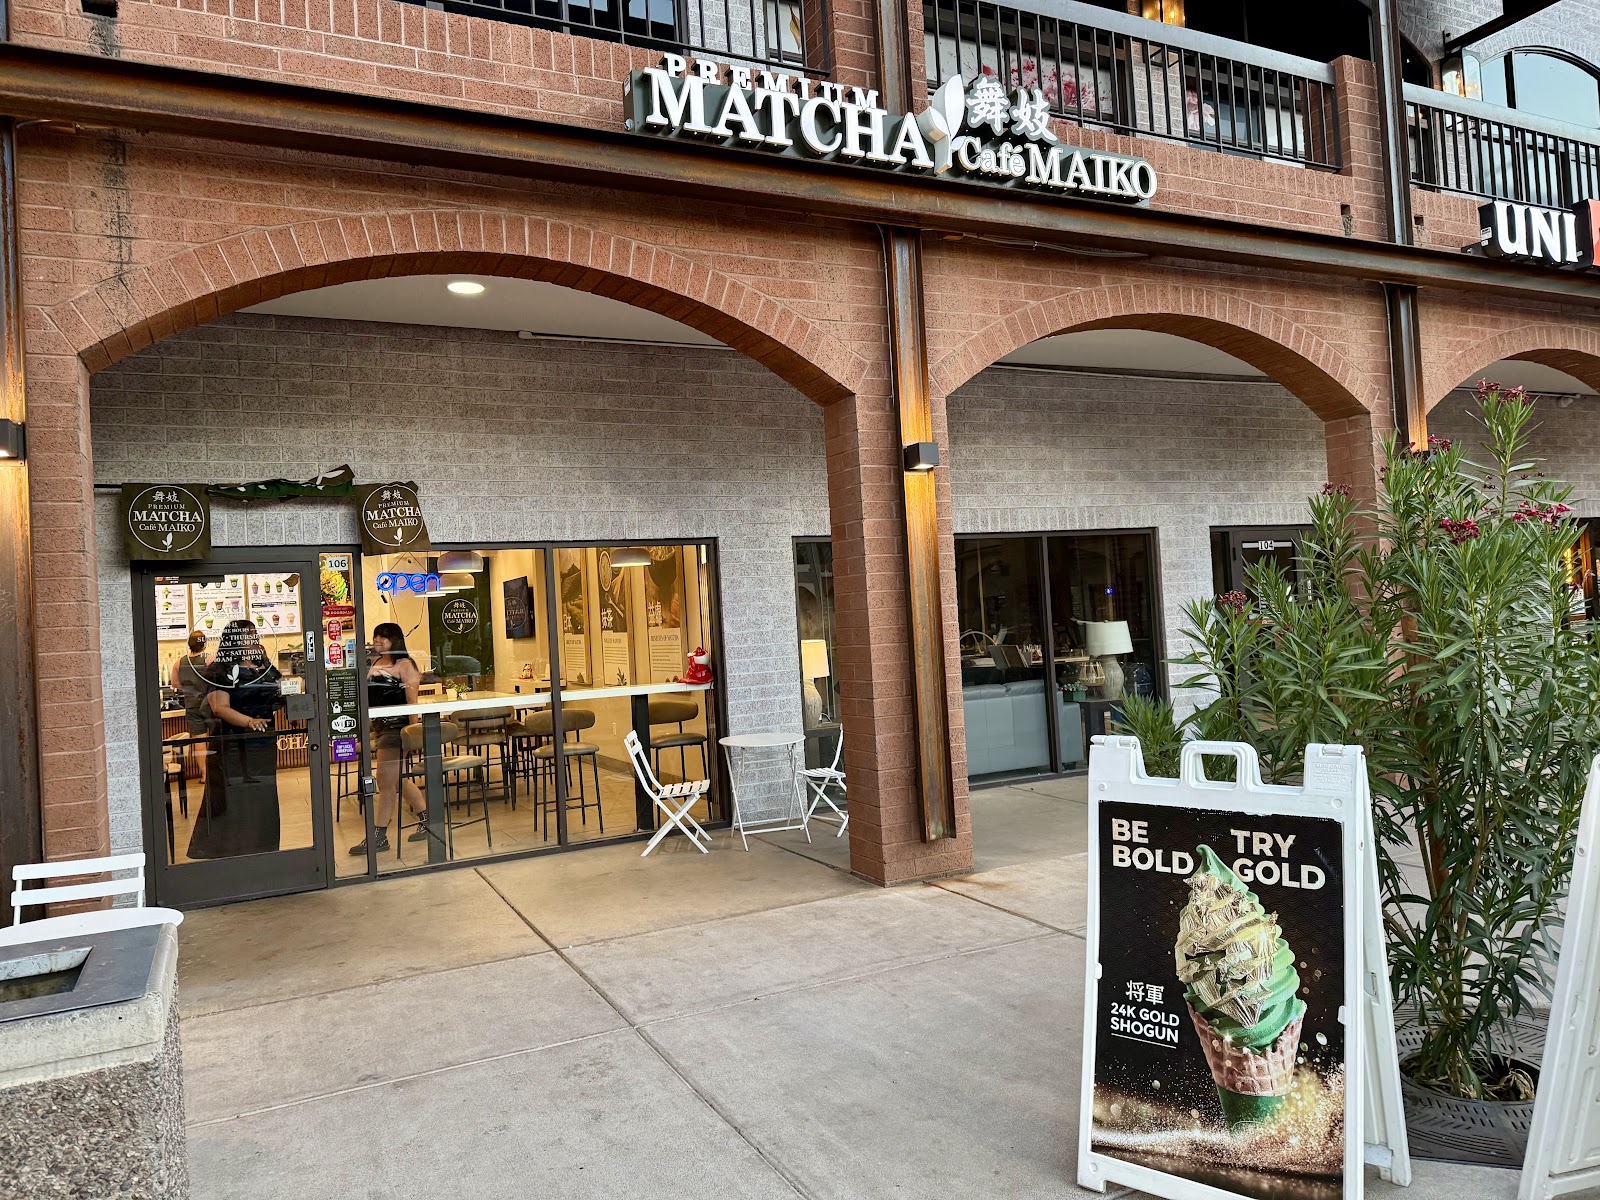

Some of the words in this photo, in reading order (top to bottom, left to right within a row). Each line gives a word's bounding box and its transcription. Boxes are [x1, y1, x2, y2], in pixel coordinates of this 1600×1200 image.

[663, 52, 879, 110] PREMIUM
[643, 66, 935, 169] MATCHA
[965, 75, 1059, 143] 舞妓
[958, 135, 1026, 177] Café
[1023, 142, 1158, 199] MAIKO
[1494, 200, 1579, 263] UNI
[132, 510, 203, 523] MATCHA
[365, 506, 422, 521] MATCHA
[378, 500, 410, 509] PREMIUM
[138, 523, 157, 531] Café
[157, 523, 196, 532] MAIKO
[372, 521, 388, 530] Café
[388, 517, 419, 528] MAIKO
[1259, 540, 1273, 550] 104
[328, 559, 347, 568] 106
[376, 571, 441, 597] open
[230, 648, 264, 656] SATURDAY
[1111, 817, 1149, 844] BE
[1230, 828, 1297, 859] TRY
[1112, 844, 1194, 875] BOLD
[1232, 857, 1326, 891] GOLD
[1125, 979, 1165, 1006] 将軍
[1110, 1001, 1137, 1019] 24K
[1139, 1007, 1180, 1027] GOLD
[1110, 1016, 1179, 1044] SHOGUN
